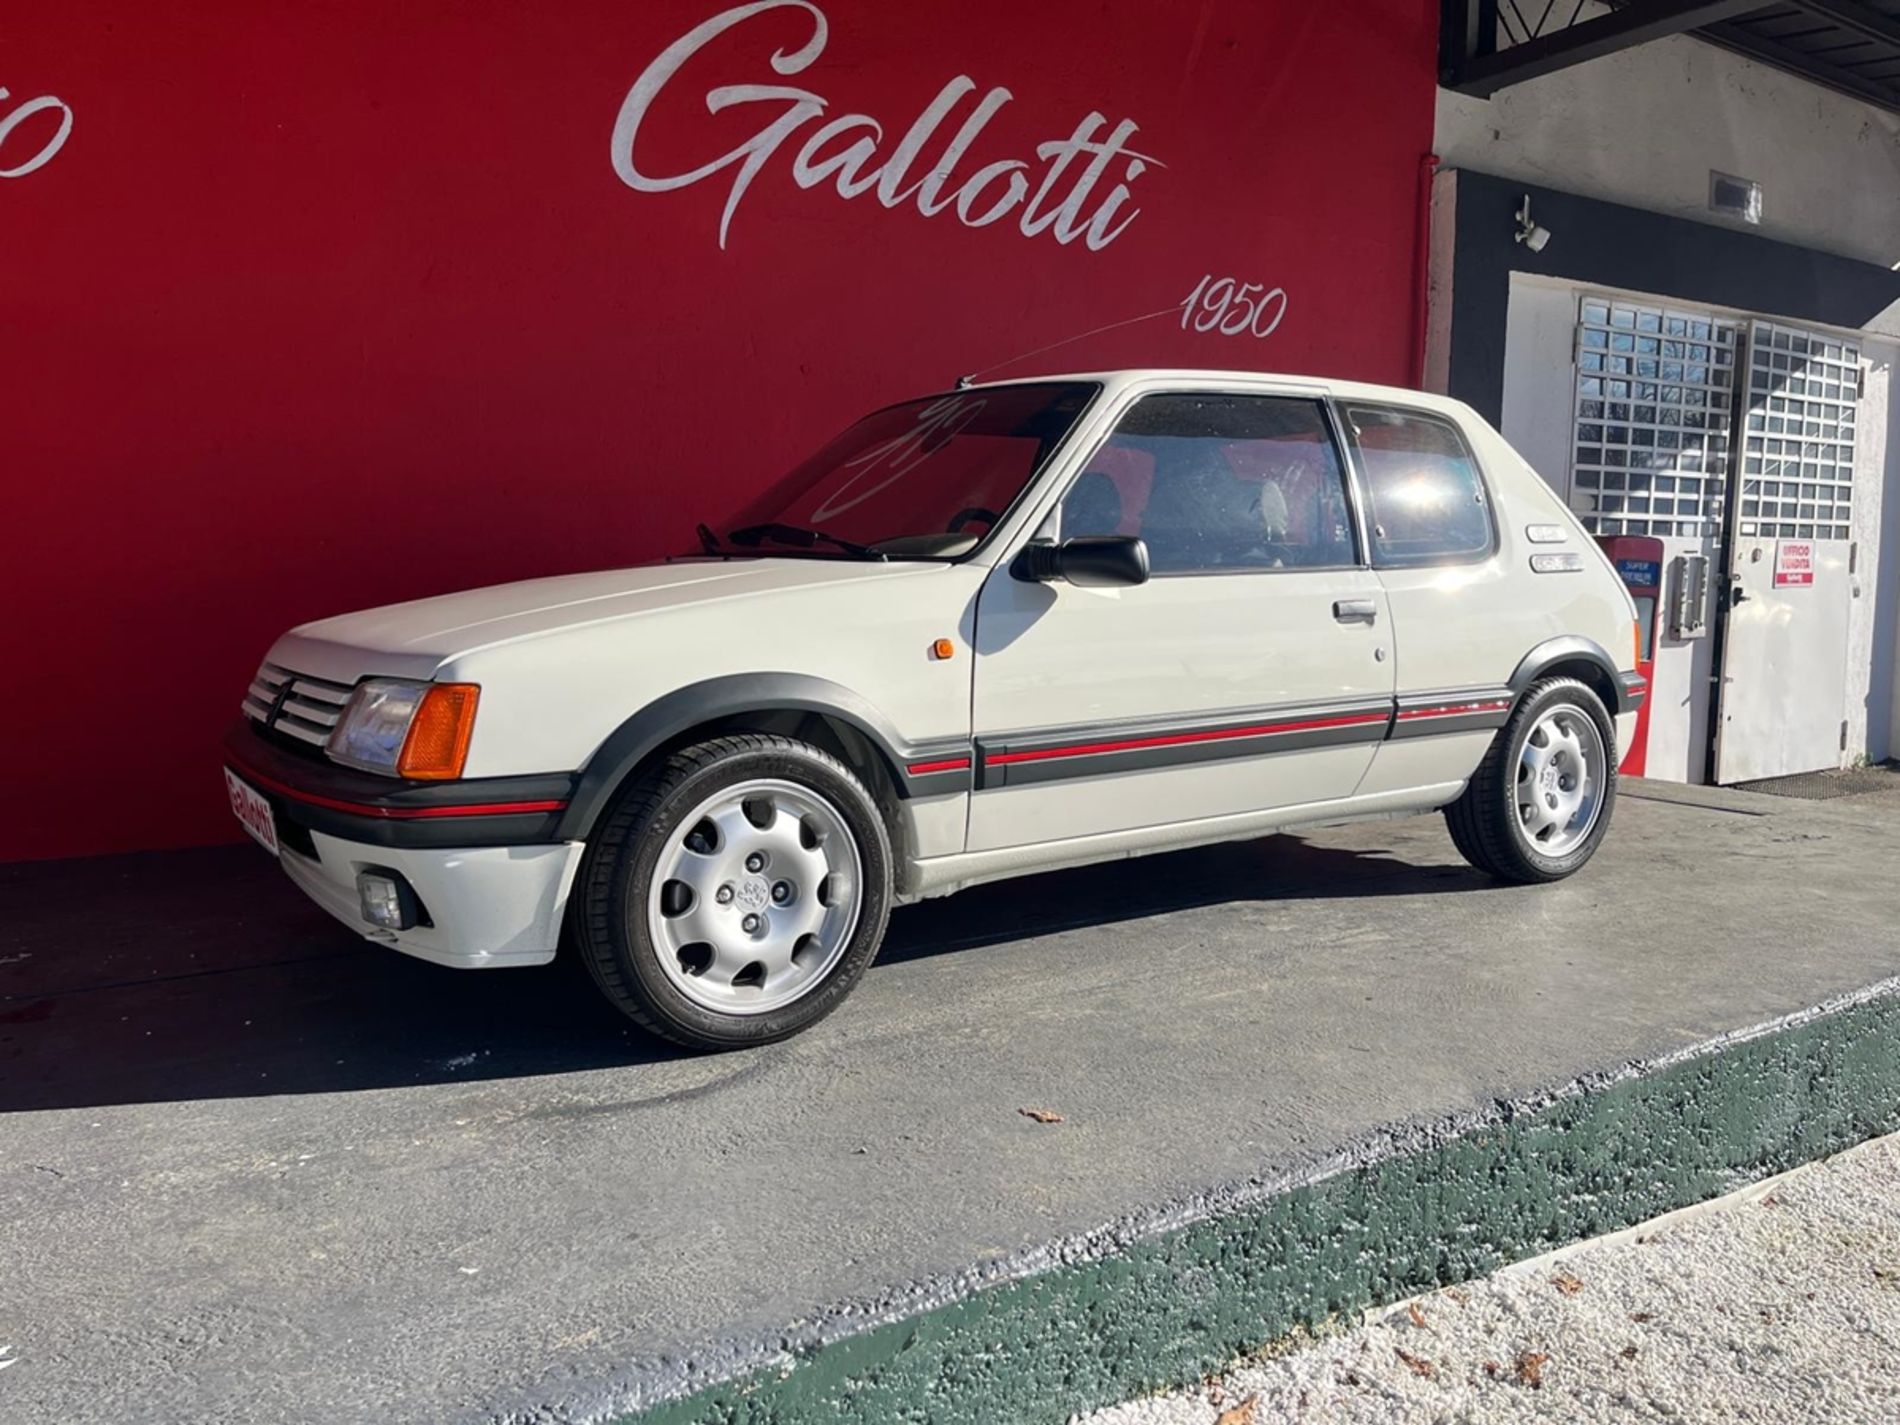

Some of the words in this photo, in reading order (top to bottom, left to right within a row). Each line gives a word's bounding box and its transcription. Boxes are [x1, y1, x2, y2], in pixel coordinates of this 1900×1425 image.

[0, 87, 73, 178] 0
[610, 0, 1168, 251] Gallotti
[1179, 274, 1286, 338] 1950
[227, 773, 276, 848] Gallotti
